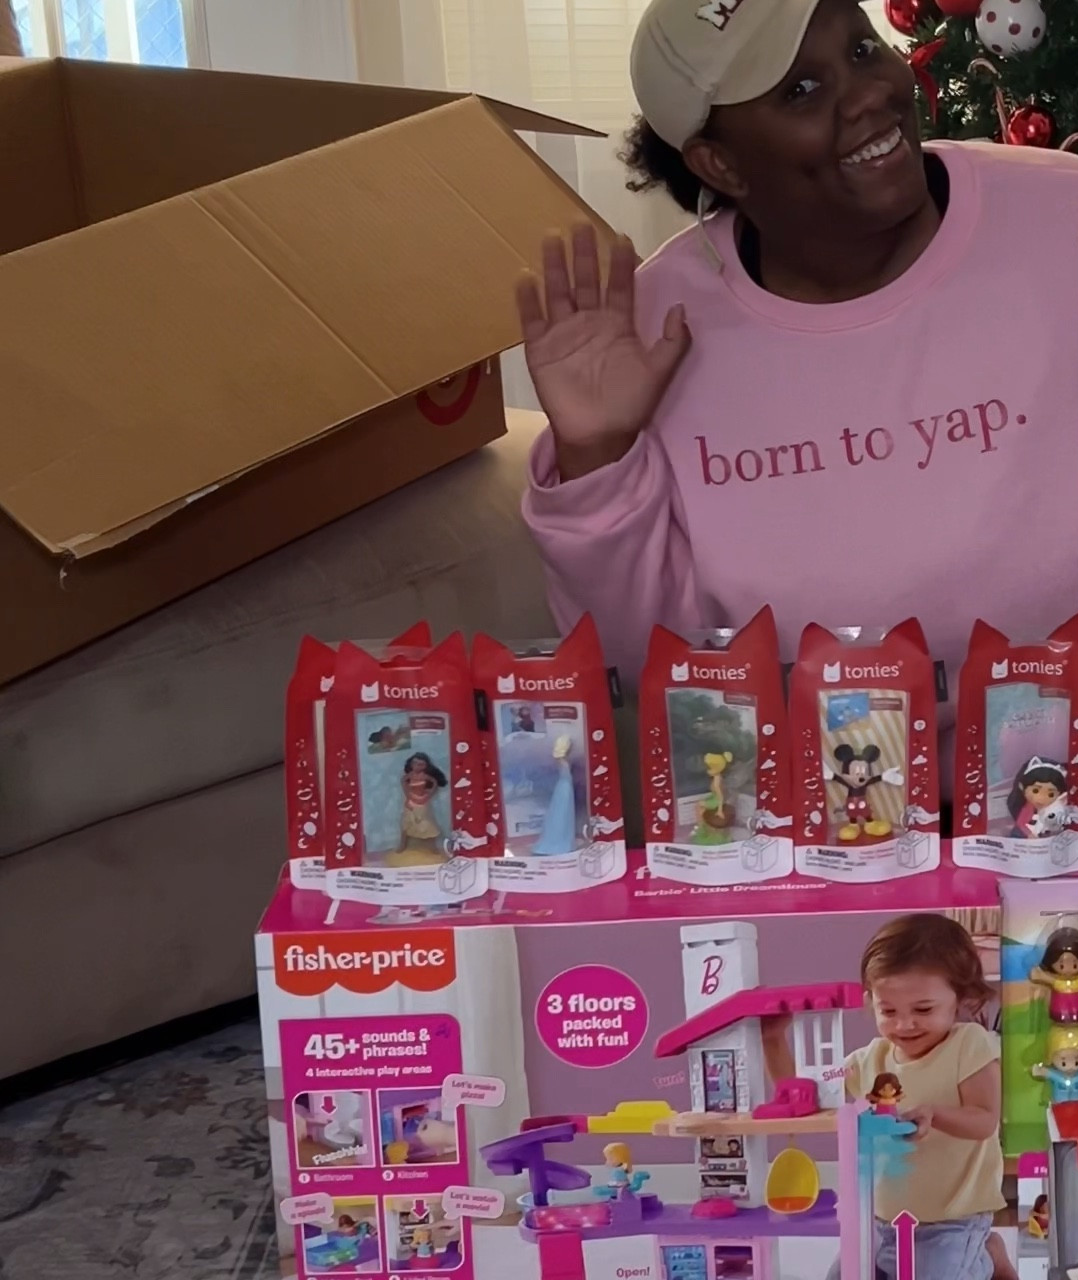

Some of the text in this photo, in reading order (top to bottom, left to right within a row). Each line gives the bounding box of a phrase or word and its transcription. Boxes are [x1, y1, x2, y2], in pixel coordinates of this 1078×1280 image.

[695, 396, 1028, 487] born to yap.
[692, 664, 748, 681] tonies
[844, 662, 900, 679] tonies
[1011, 659, 1064, 676] tonies
[383, 682, 440, 700] tonies
[518, 675, 575, 693] tonies
[690, 885, 730, 894] Little
[283, 943, 446, 975] fisher-price
[701, 955, 723, 995] B
[547, 993, 636, 1014] 3 floors
[562, 1014, 622, 1034] packed
[304, 1028, 431, 1060] 45+ sounds &
[557, 1031, 629, 1048] with fun!
[362, 1044, 427, 1061] phrases!
[305, 1065, 432, 1077] 4 interactive play areas
[616, 1266, 650, 1280] Open!
